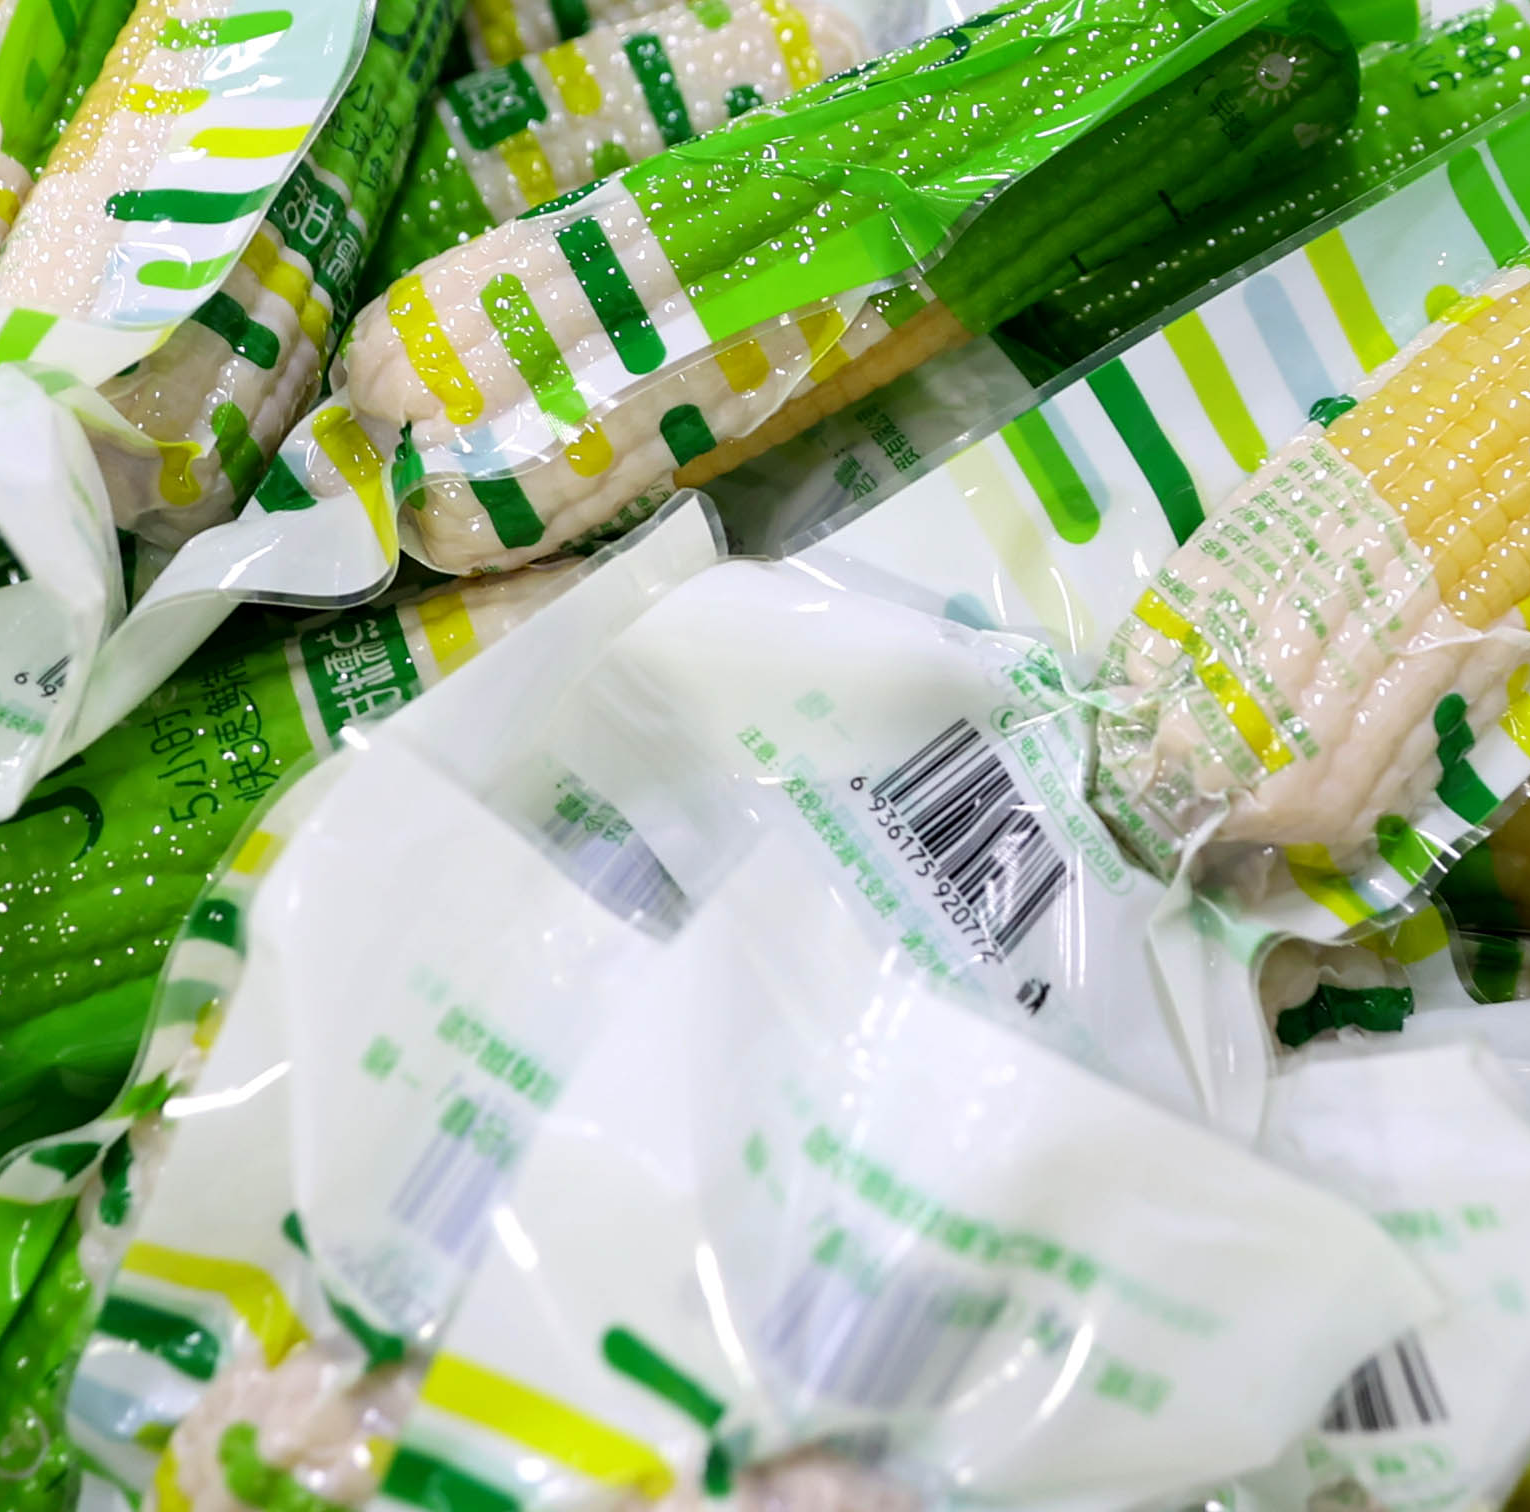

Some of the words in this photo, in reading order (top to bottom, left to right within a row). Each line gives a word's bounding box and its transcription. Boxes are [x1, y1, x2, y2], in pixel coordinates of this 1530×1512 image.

[142, 706, 220, 824] 5小时
[845, 770, 870, 795] 6
[865, 793, 939, 880] 936175
